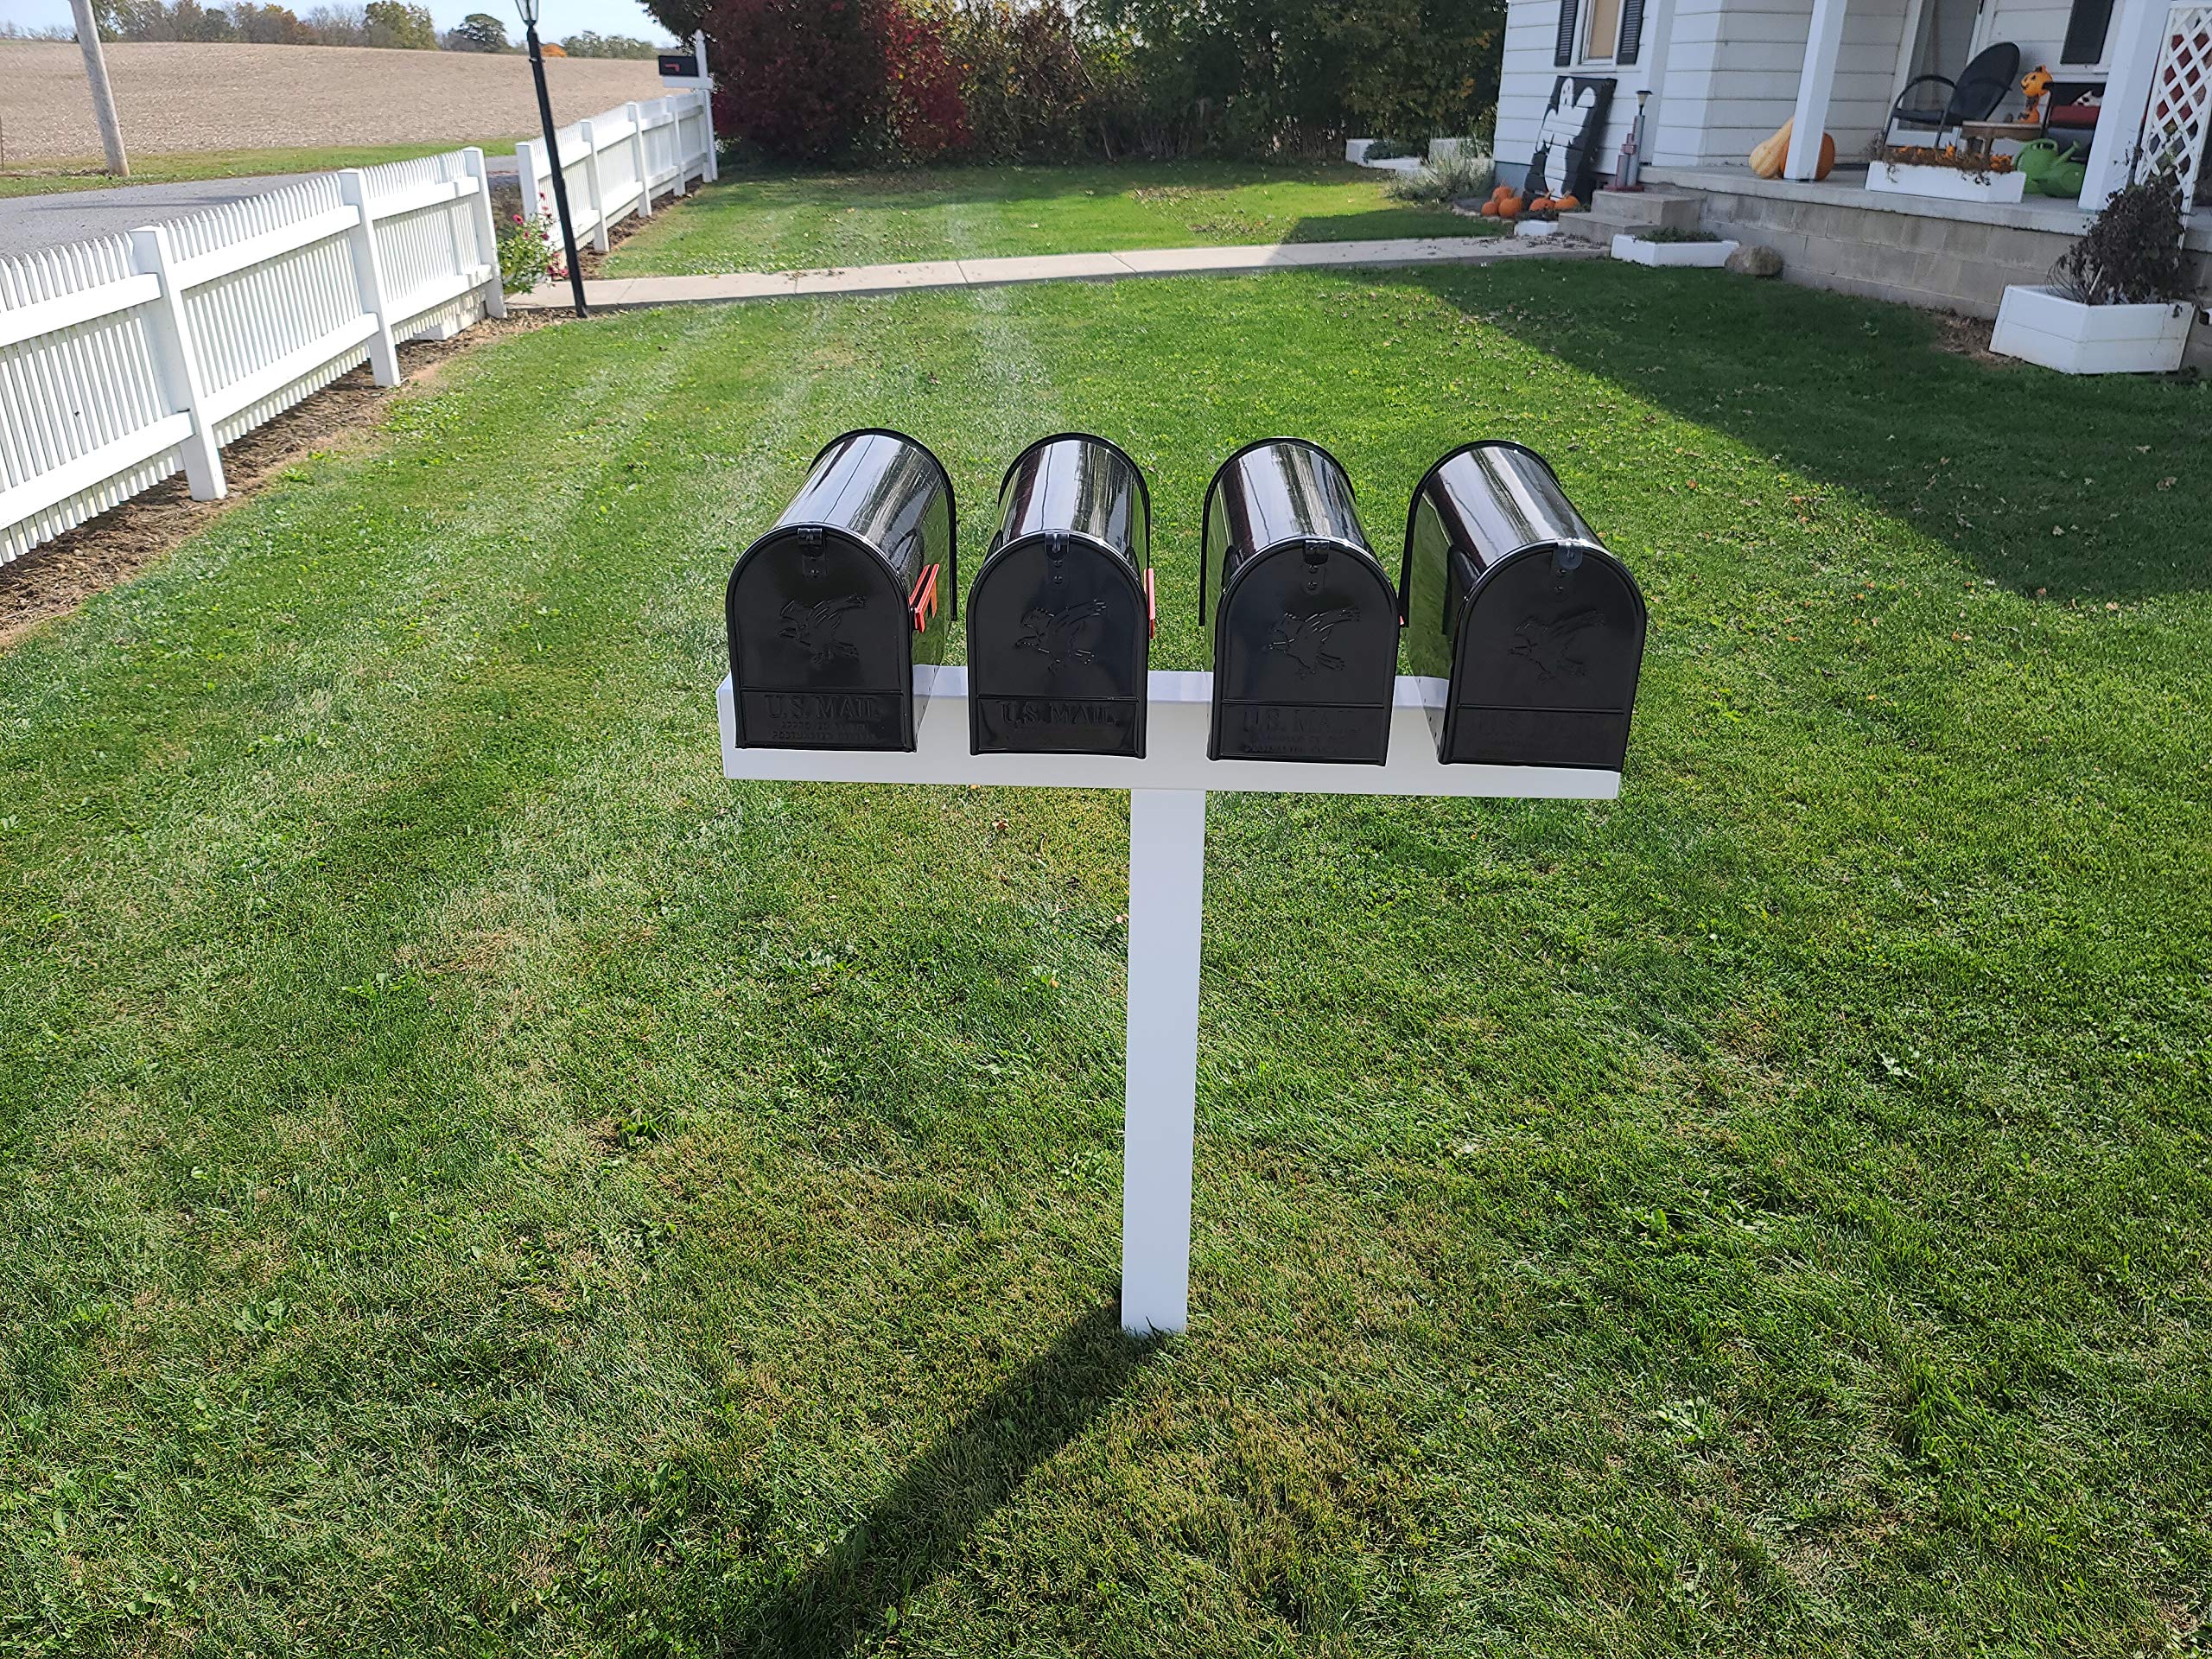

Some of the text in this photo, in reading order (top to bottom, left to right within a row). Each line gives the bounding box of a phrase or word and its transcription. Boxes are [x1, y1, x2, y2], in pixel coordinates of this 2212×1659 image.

[765, 694, 880, 721] U.S. MAIL
[996, 700, 1120, 727] U.S. MAIL
